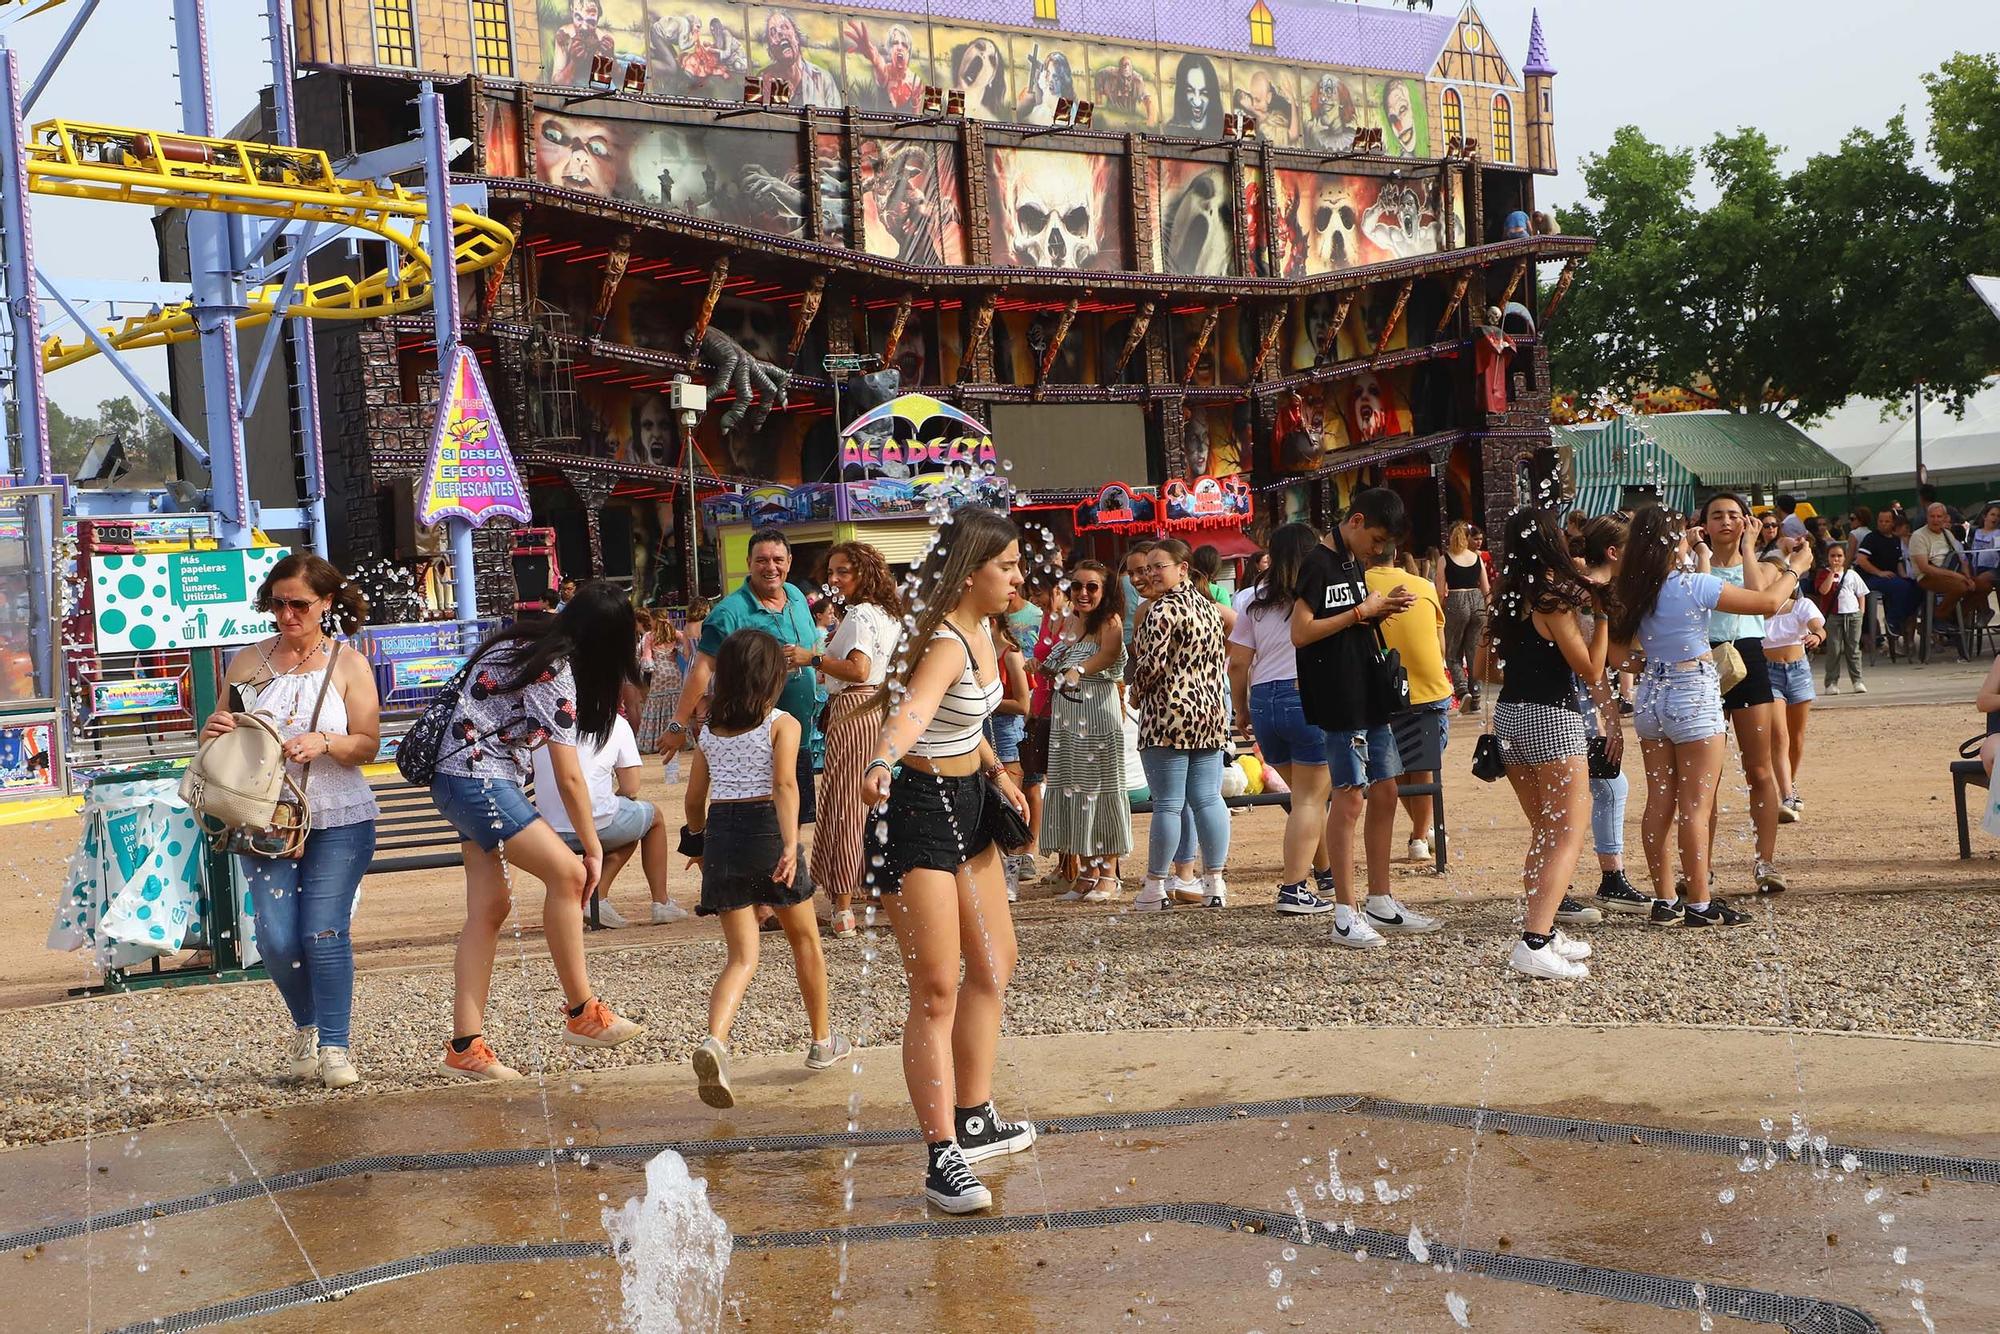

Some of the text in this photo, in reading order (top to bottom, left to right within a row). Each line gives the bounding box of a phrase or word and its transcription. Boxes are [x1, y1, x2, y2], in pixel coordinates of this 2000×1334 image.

[453, 399, 485, 409] PULSE
[441, 448, 502, 460] SI DESEA
[842, 435, 997, 469] ALADELTA
[441, 465, 506, 478] EFECTOS
[436, 481, 515, 498] REFRESCANTES
[180, 555, 200, 565] Más
[181, 564, 226, 575] papeleras
[181, 575, 199, 584] que
[182, 584, 220, 592] lunares.
[183, 591, 228, 602] Utilízalas
[241, 620, 275, 635] sade
